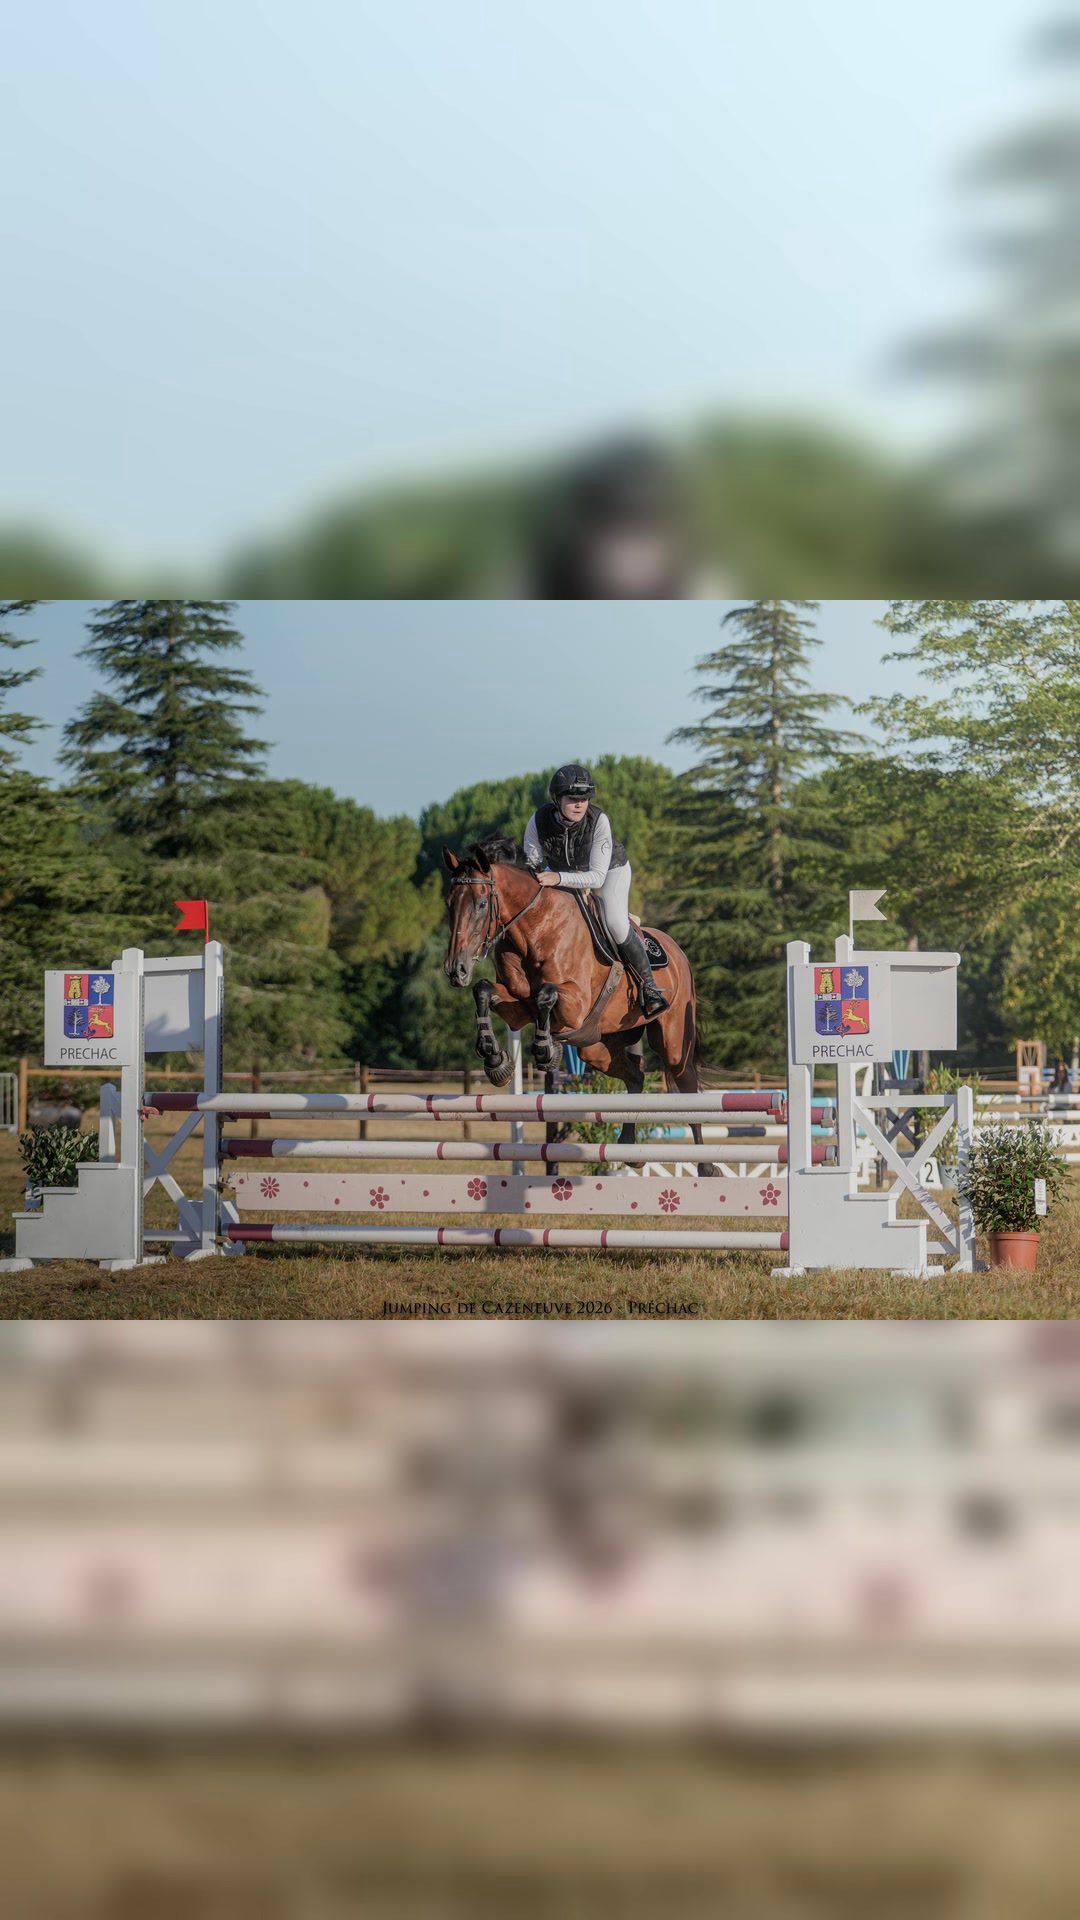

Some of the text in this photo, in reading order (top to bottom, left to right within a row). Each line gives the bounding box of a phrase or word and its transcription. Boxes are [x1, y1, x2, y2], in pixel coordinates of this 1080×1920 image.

[60, 1048, 117, 1060] PRECHAC
[812, 1044, 874, 1057] PRECHAC
[924, 1162, 935, 1183] 2
